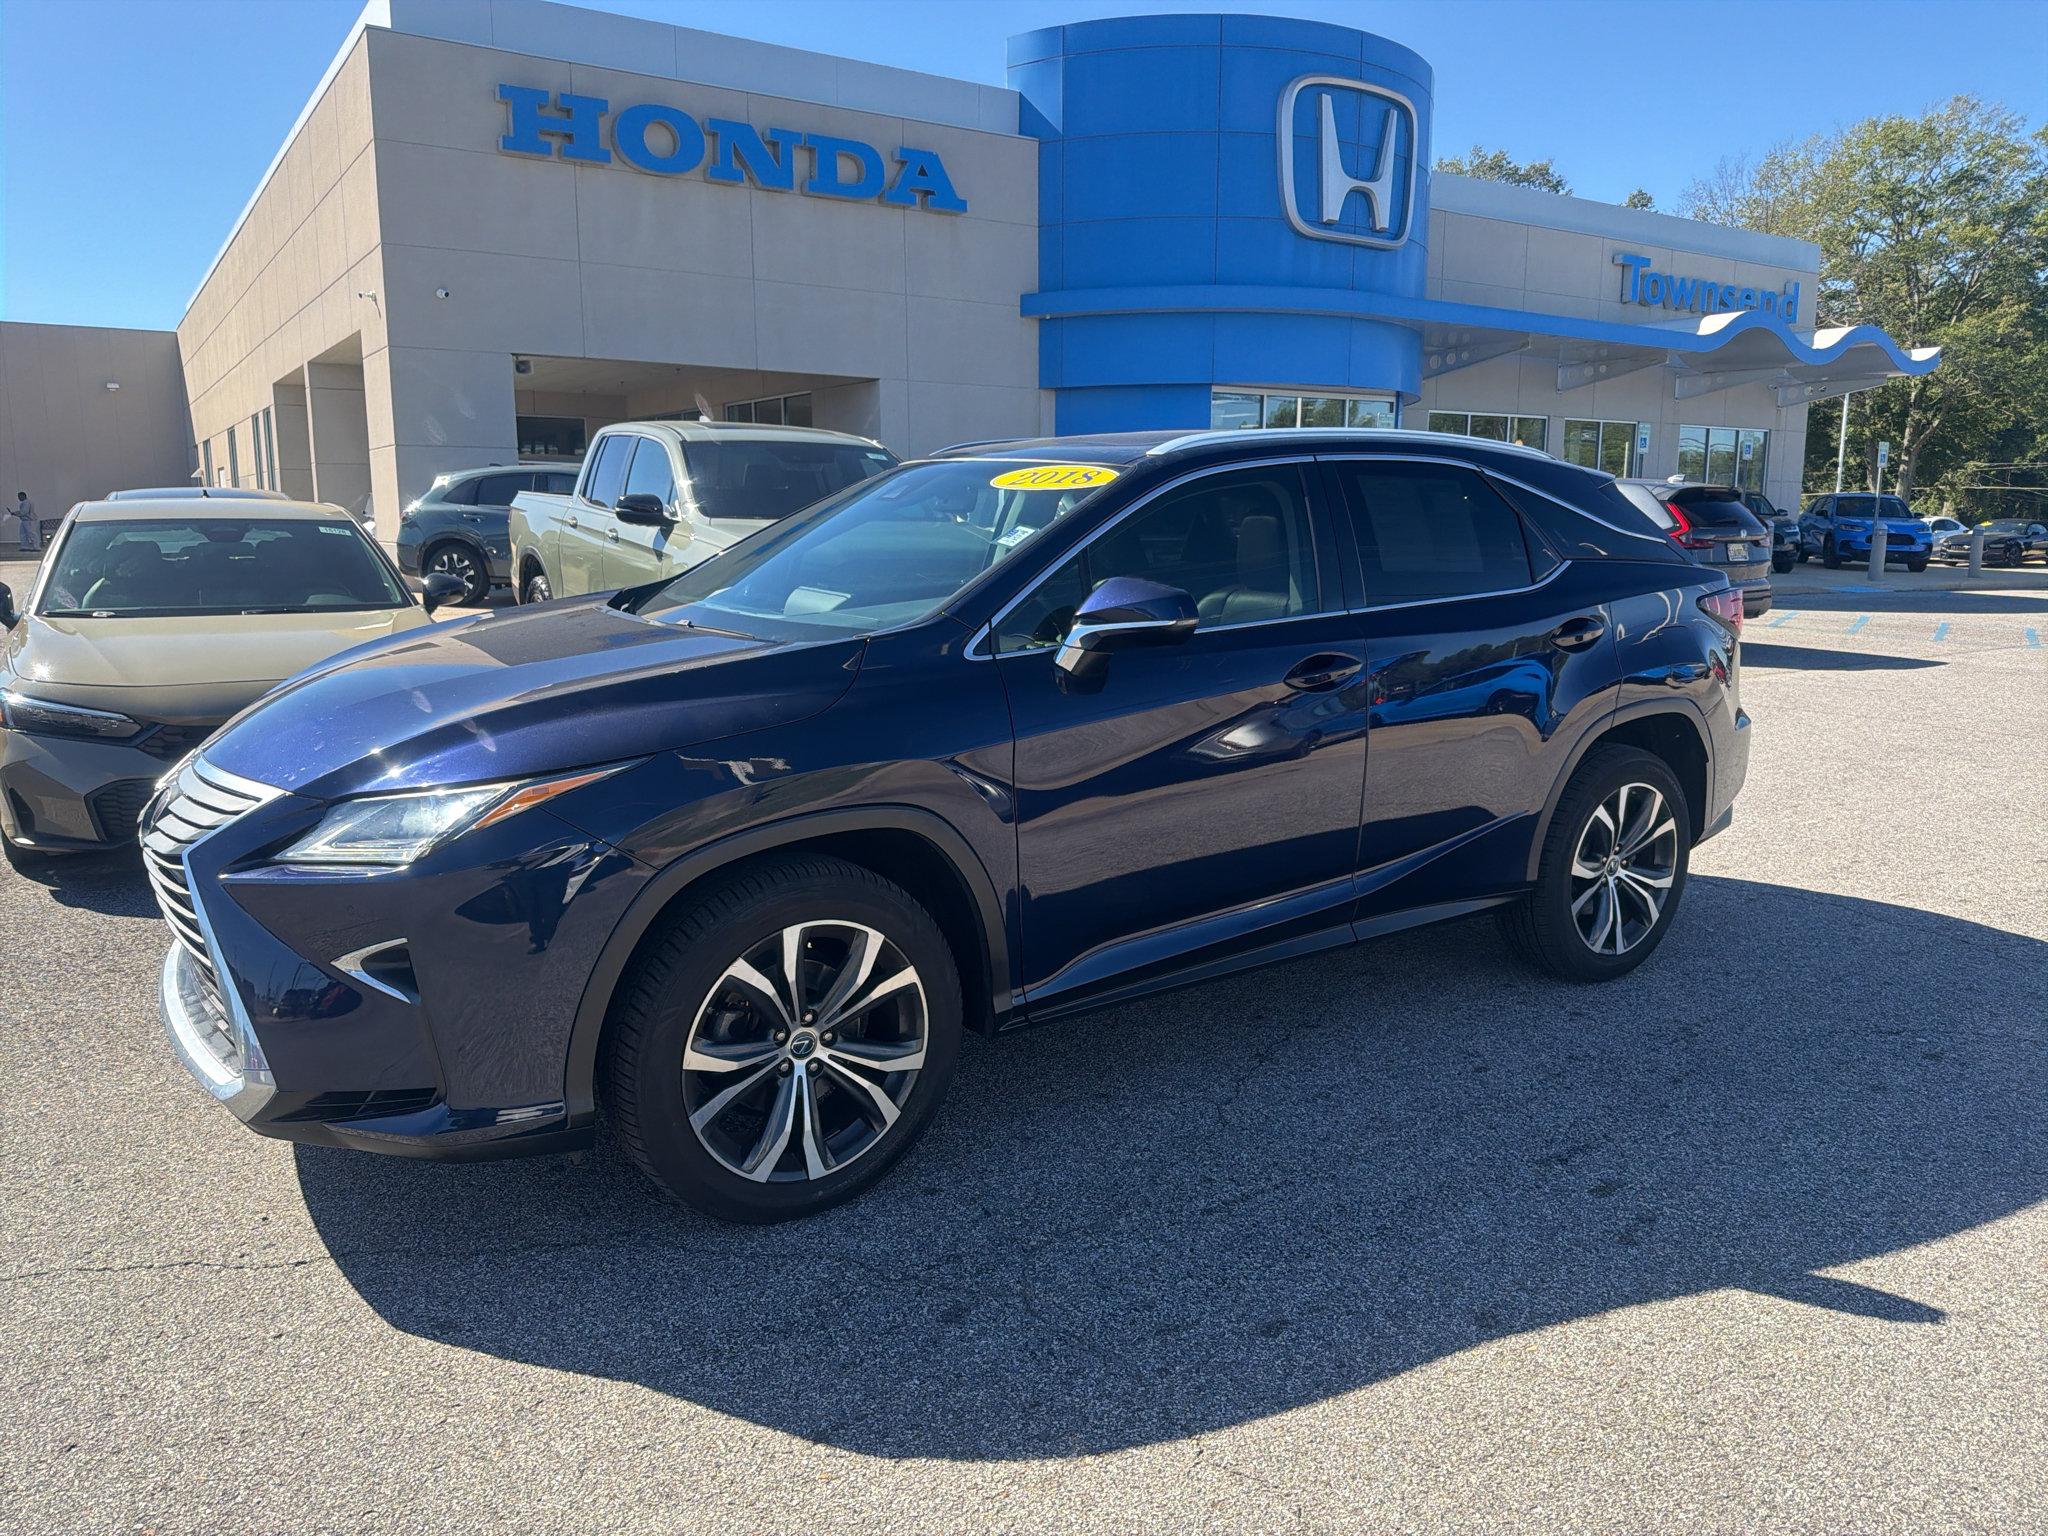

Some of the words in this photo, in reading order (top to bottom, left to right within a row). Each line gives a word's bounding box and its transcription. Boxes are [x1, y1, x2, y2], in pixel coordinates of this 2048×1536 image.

[495, 83, 967, 213] HONDA
[1613, 253, 1800, 324] Townsend
[1007, 470, 1102, 486] 2018
